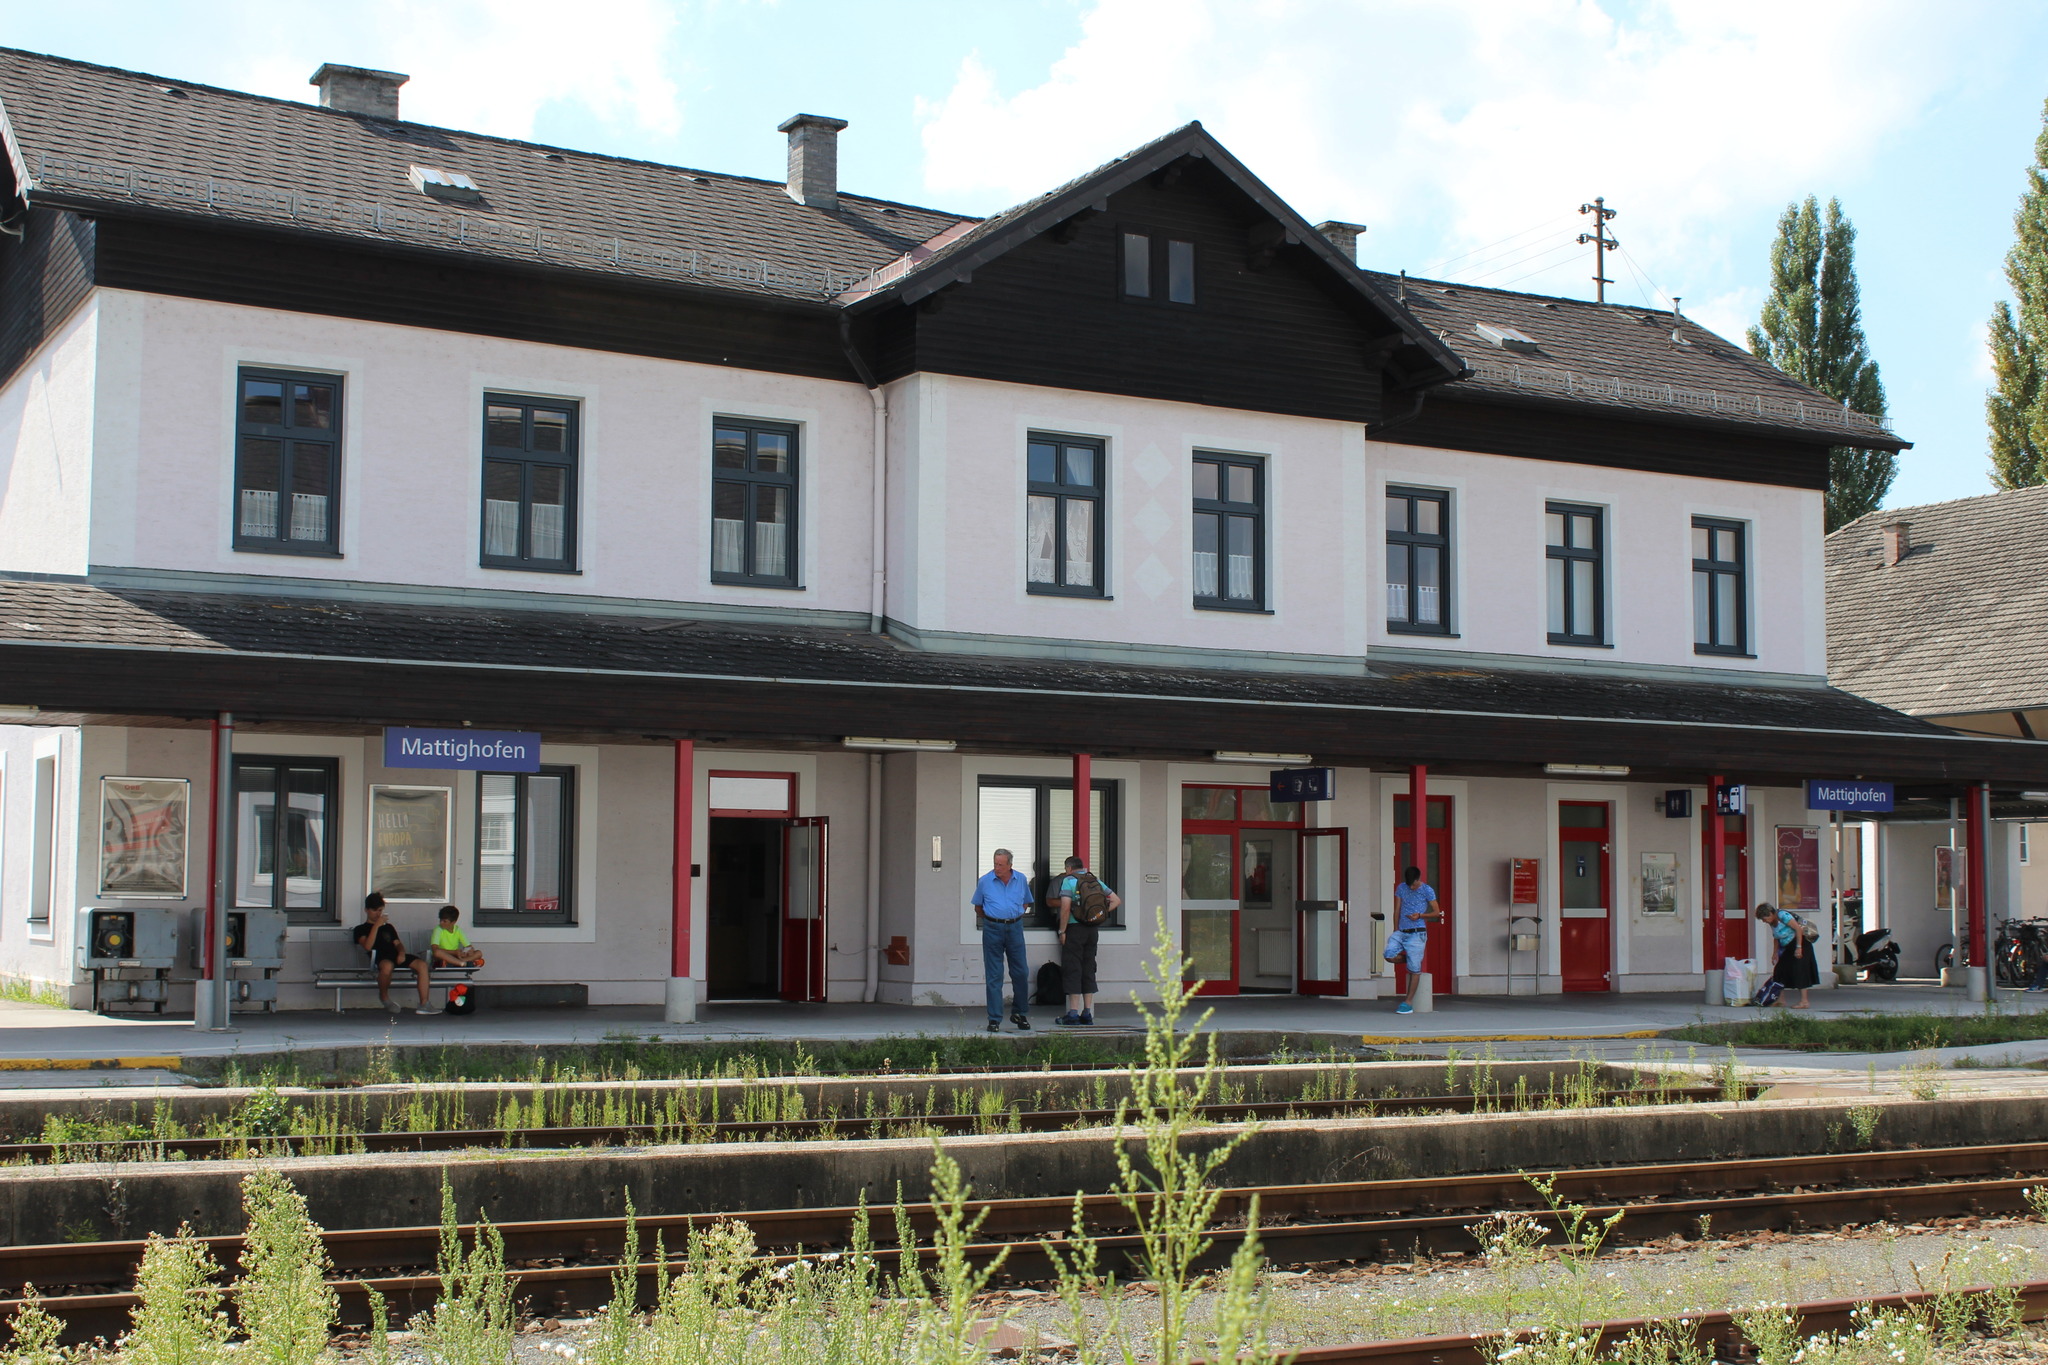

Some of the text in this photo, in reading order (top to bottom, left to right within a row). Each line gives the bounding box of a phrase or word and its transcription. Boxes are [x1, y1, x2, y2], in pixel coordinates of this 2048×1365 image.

[401, 737, 525, 762] Mattighofen
[1818, 787, 1886, 804] Mattighofen
[378, 813, 409, 829] HELLO
[378, 831, 413, 848] EUROPA
